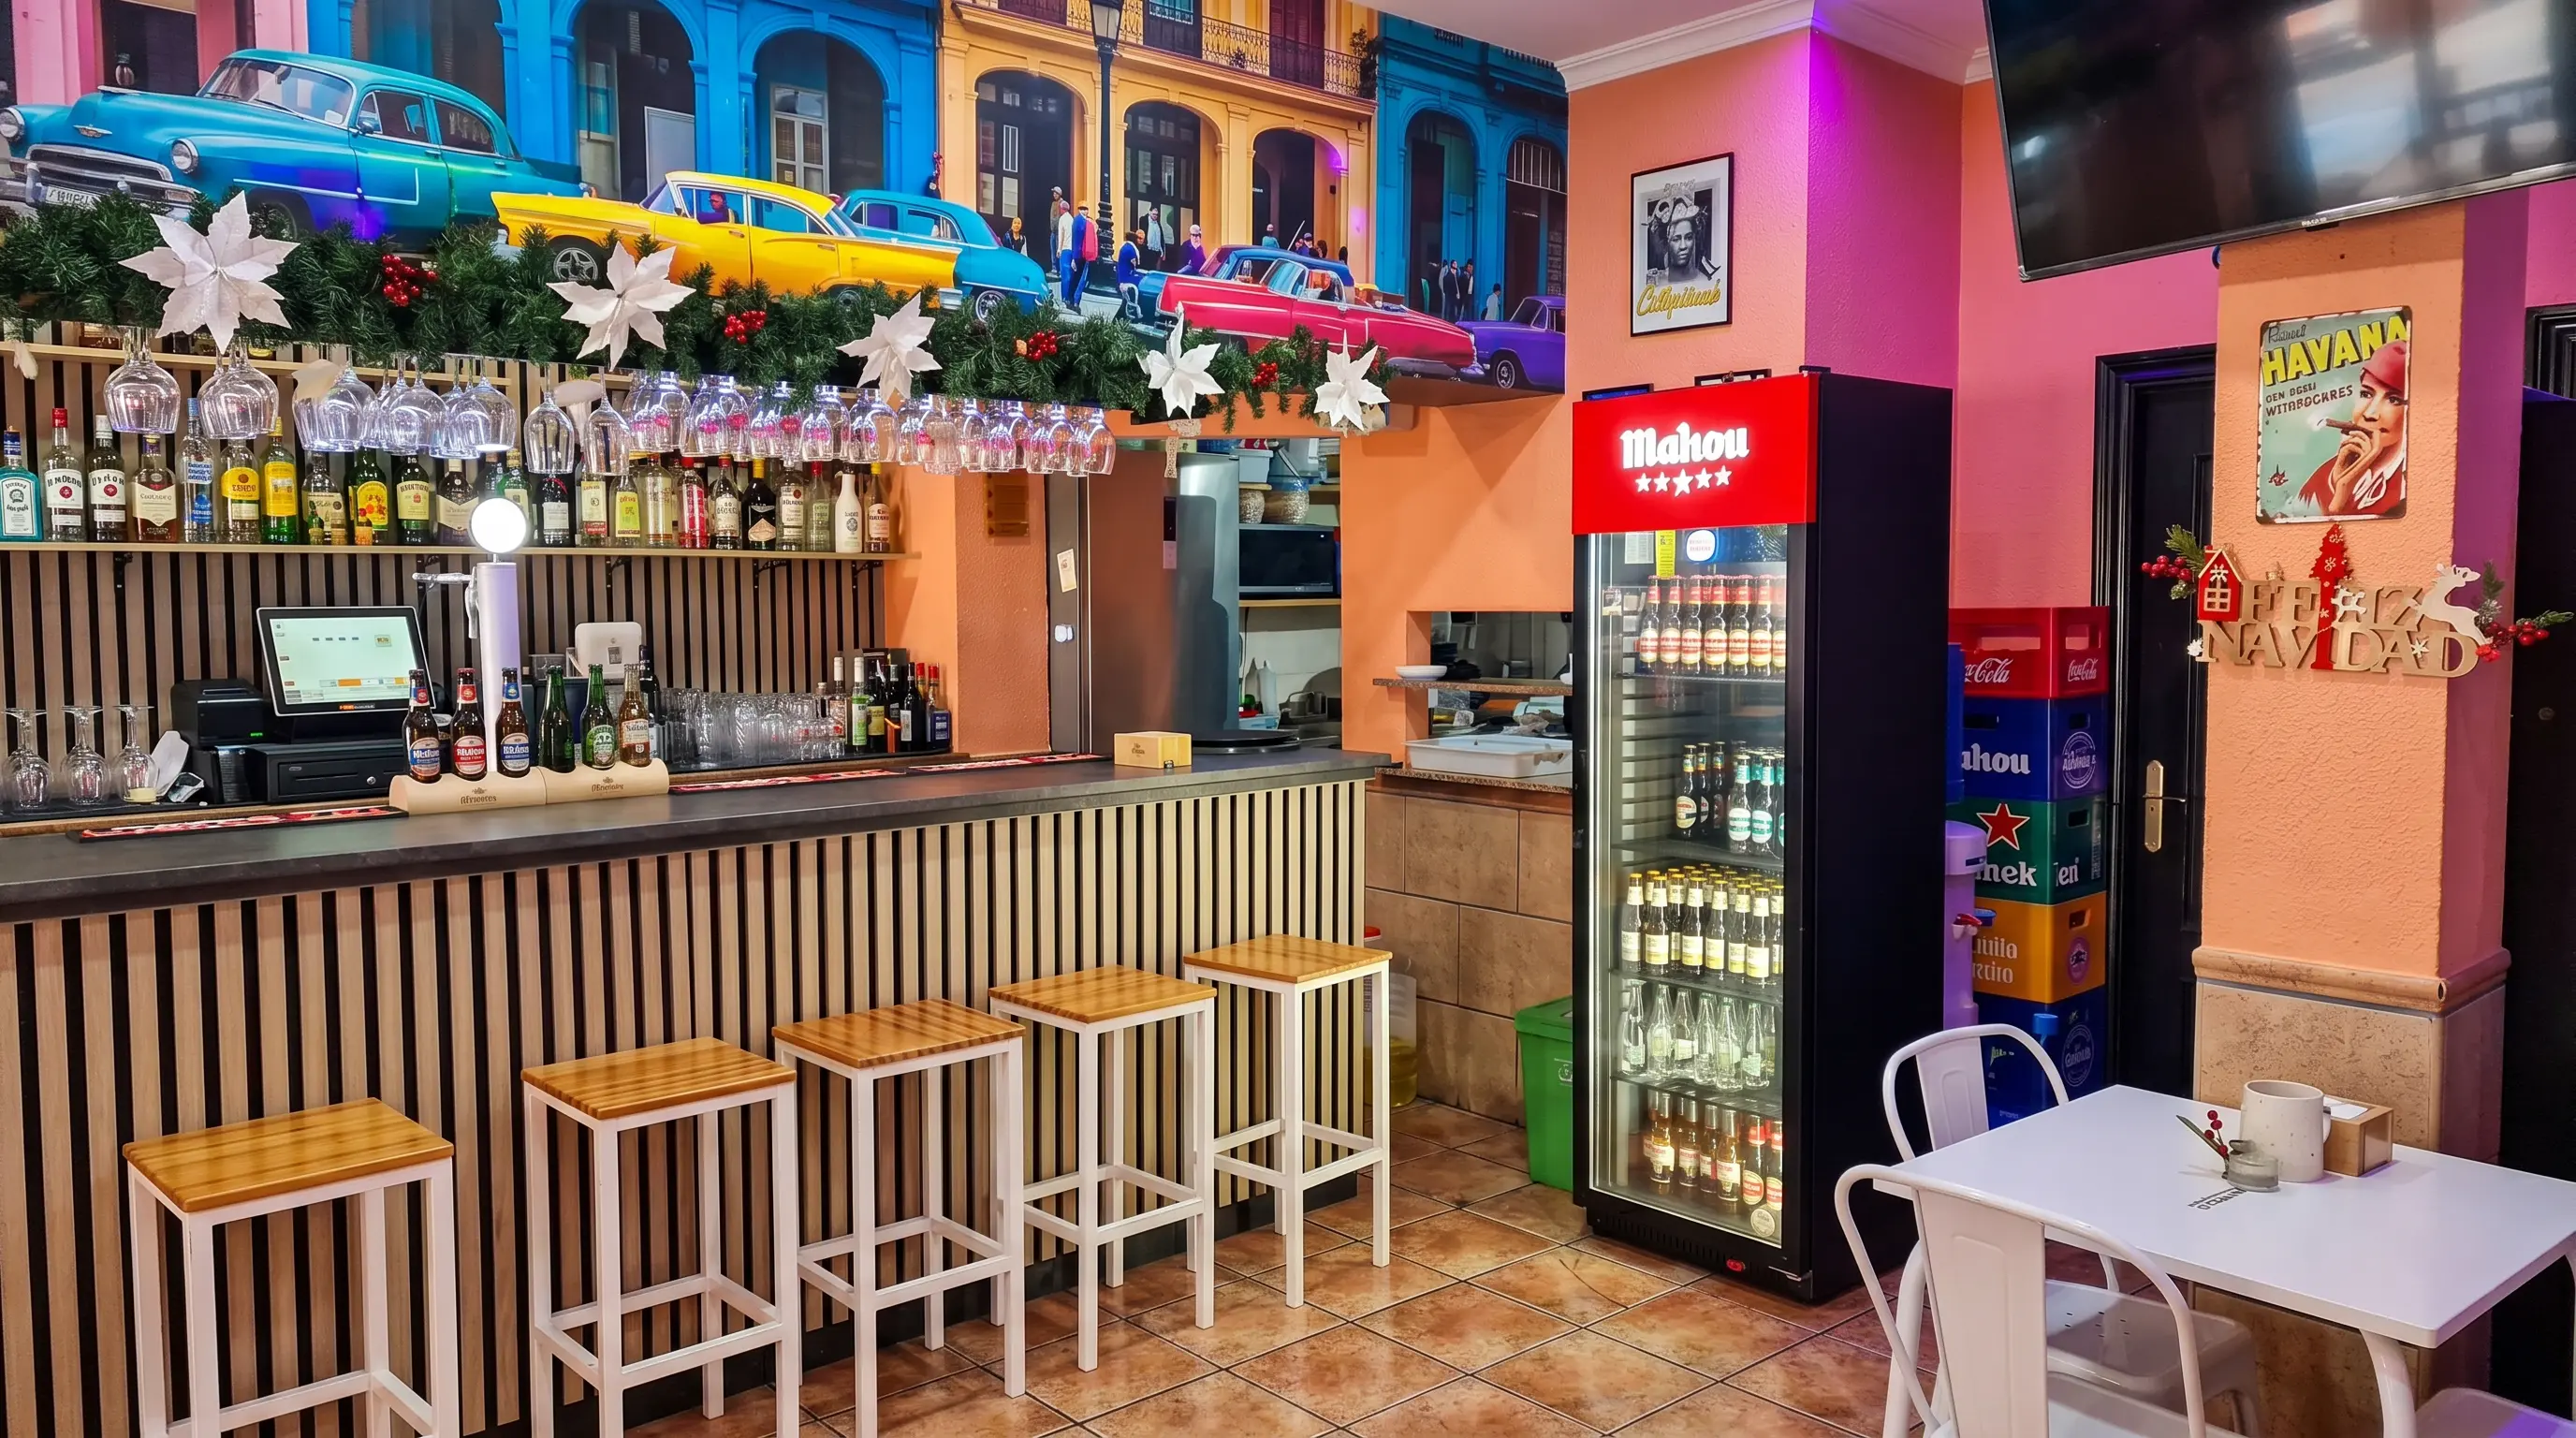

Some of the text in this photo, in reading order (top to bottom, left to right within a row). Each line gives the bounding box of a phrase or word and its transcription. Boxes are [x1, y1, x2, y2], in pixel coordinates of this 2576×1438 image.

[2261, 315, 2408, 387] HAVANA
[1619, 421, 1750, 469] Mahou
[2195, 619, 2480, 679] NAVIDAD
[1961, 742, 2031, 775] ahou
